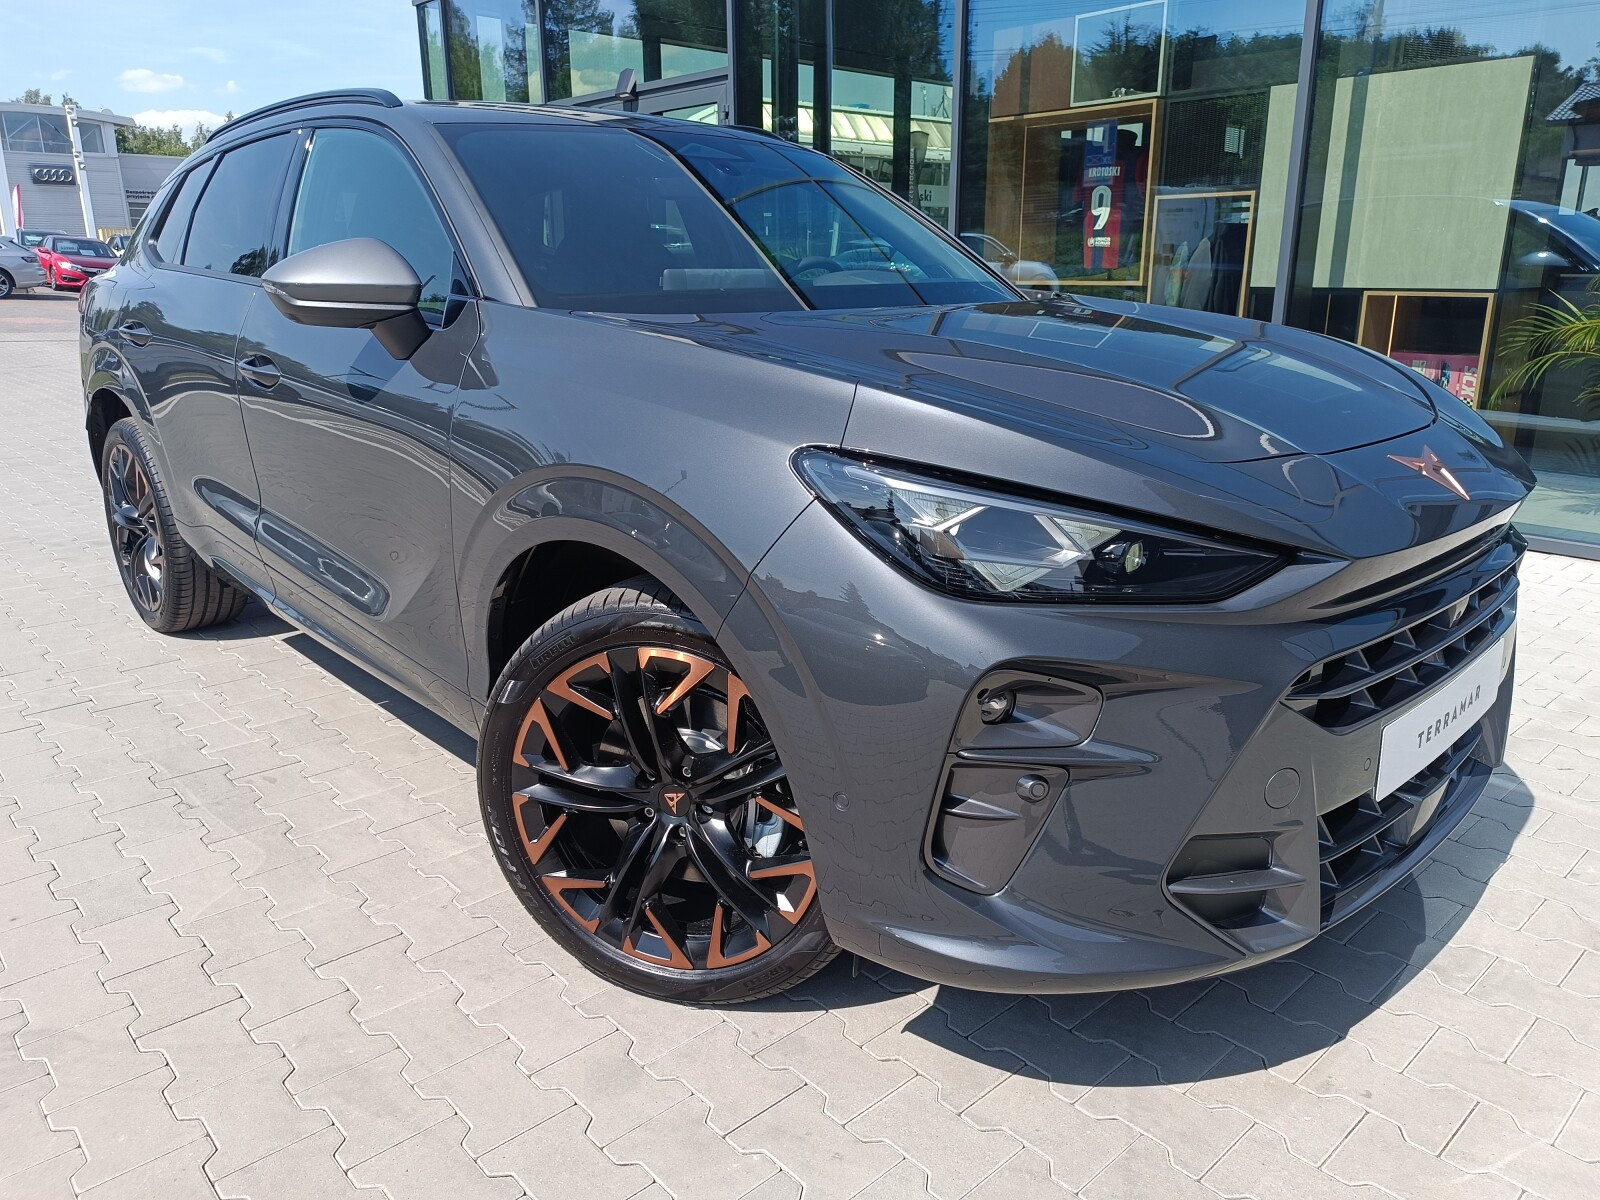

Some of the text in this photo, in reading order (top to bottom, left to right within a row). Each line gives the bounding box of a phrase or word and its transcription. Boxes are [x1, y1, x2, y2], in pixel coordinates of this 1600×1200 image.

[1088, 166, 1121, 177] KROTOSKI
[1091, 185, 1112, 230] 9
[1417, 684, 1481, 749] TERRAMAR
